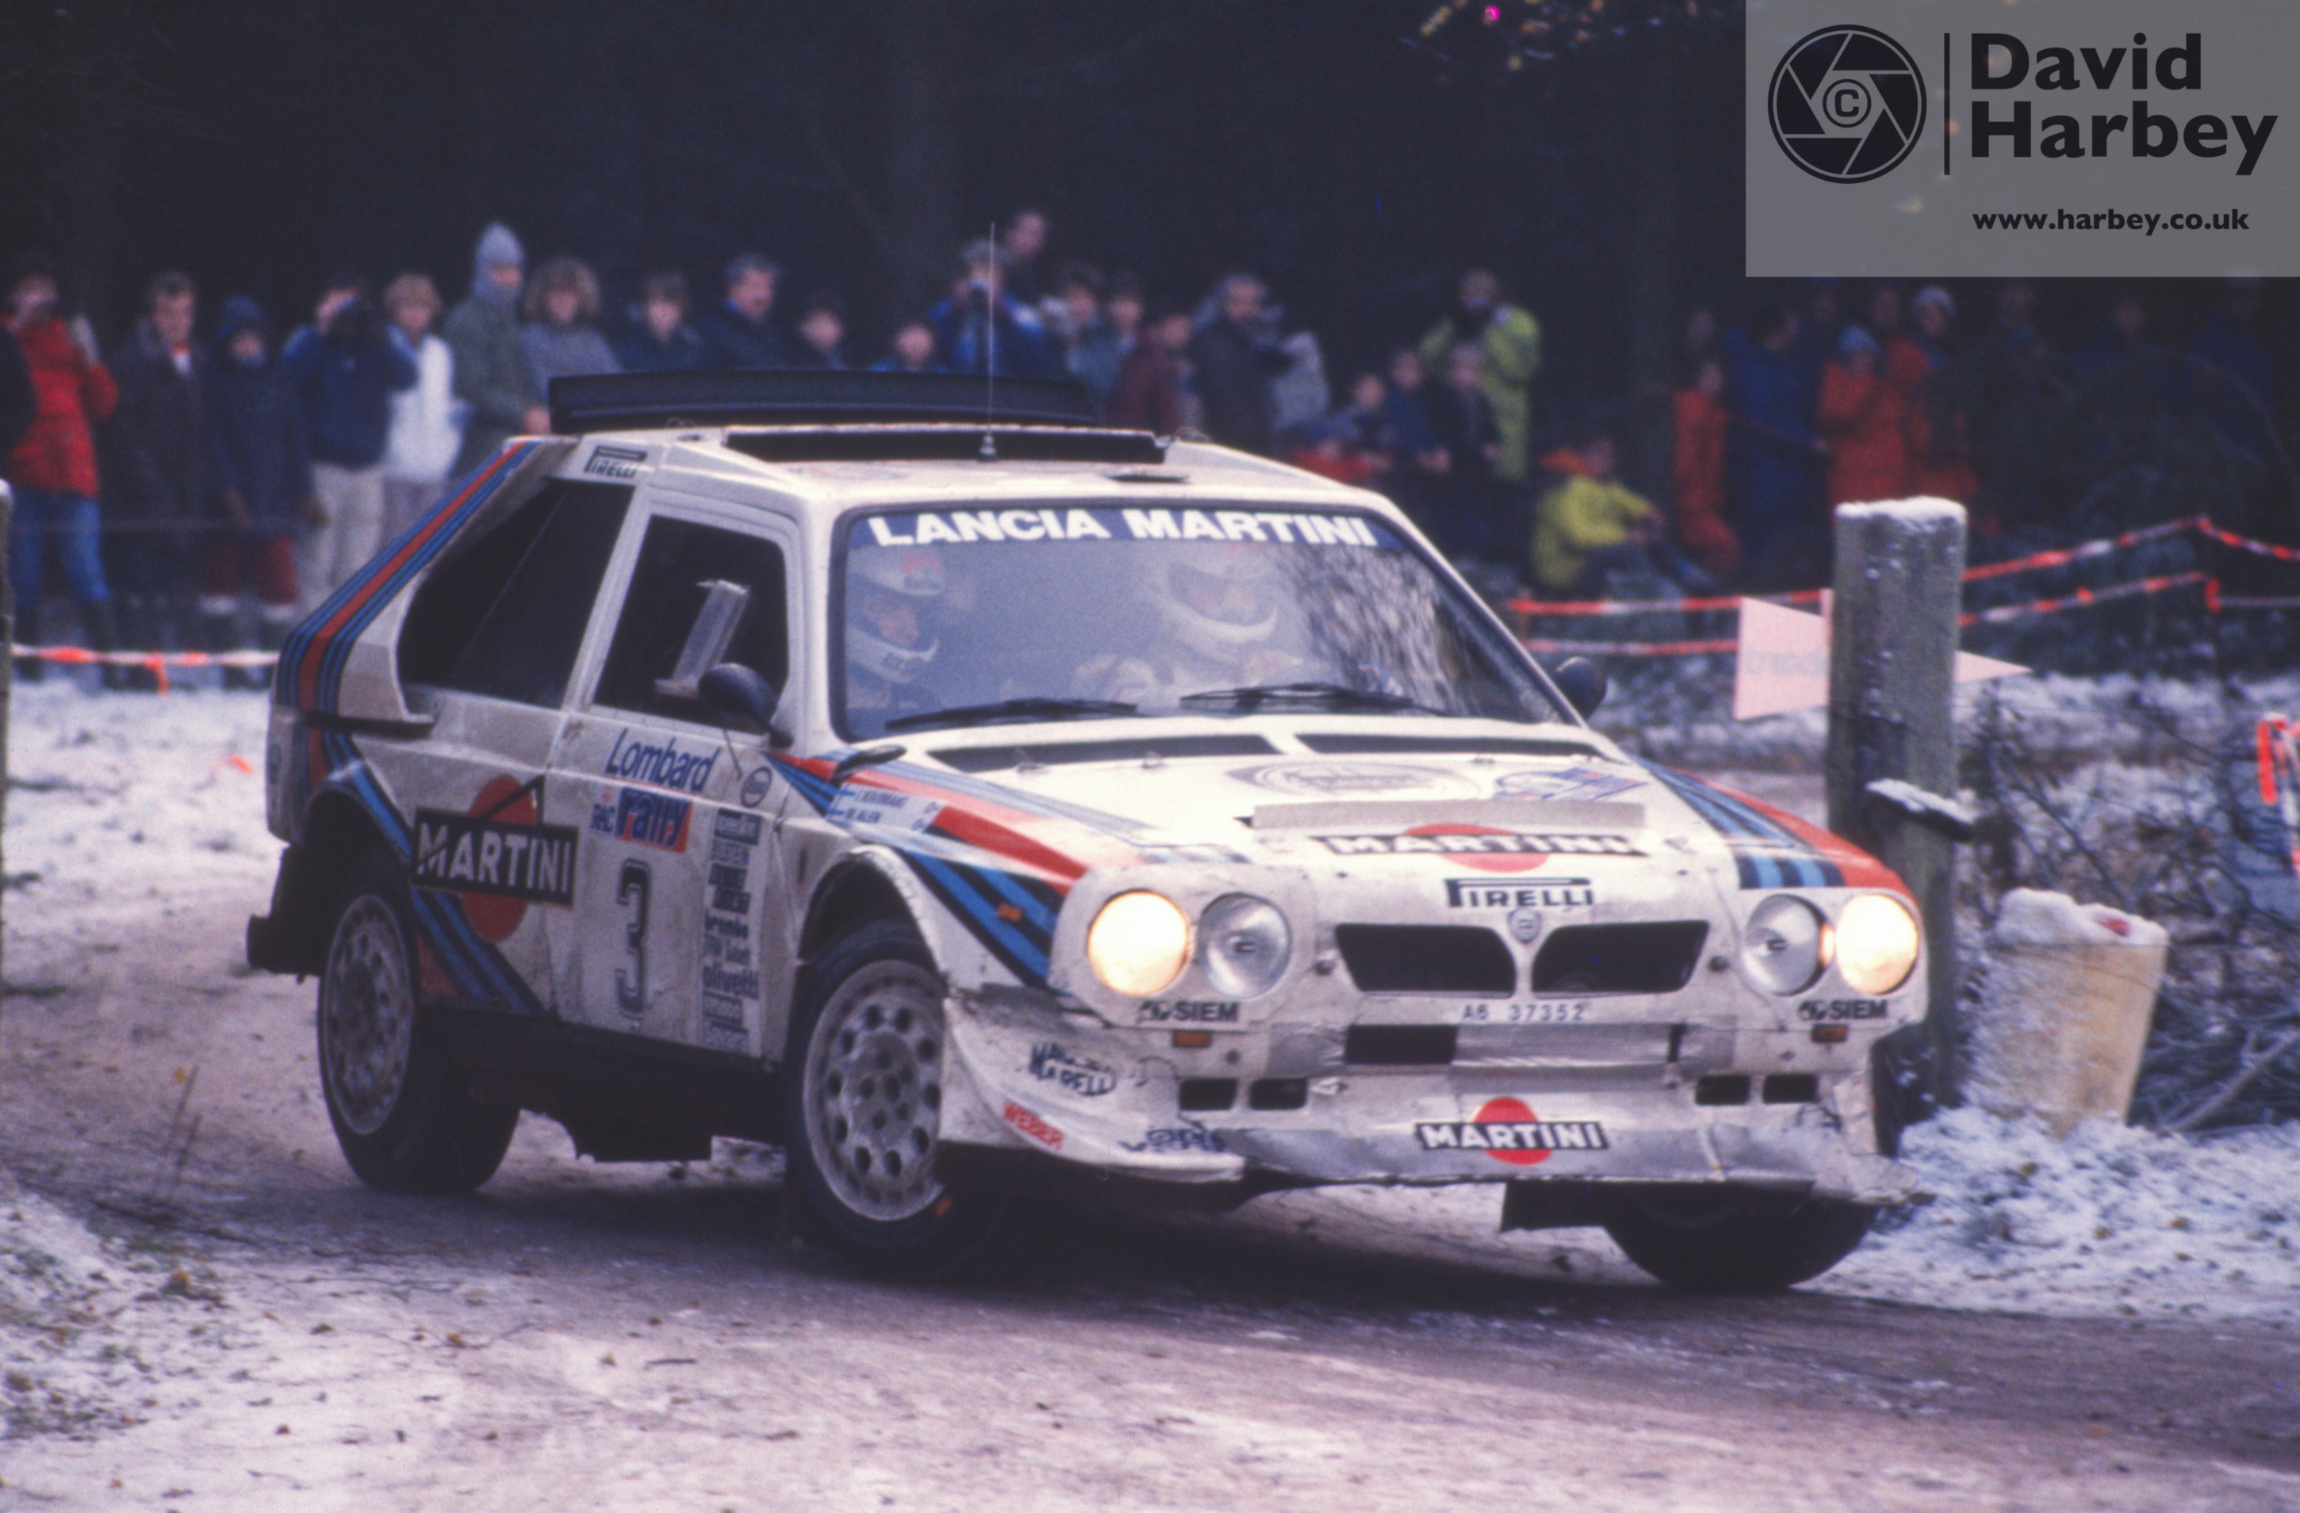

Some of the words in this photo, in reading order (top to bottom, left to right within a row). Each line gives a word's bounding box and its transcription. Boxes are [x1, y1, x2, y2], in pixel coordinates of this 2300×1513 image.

[584, 446, 647, 478] PIRELLI
[870, 510, 1109, 546] LANCIA
[1130, 508, 1378, 547] MARTINI
[605, 728, 718, 792] Lombard
[417, 821, 572, 894] MARTINI
[1324, 835, 1636, 855] MARTINI
[1446, 878, 1594, 907] PIRELLI
[615, 858, 652, 1018] 3
[1174, 1001, 1239, 1021] SIEM
[1830, 1001, 1888, 1019] SIEM
[1422, 1122, 1602, 1151] MARTINI
